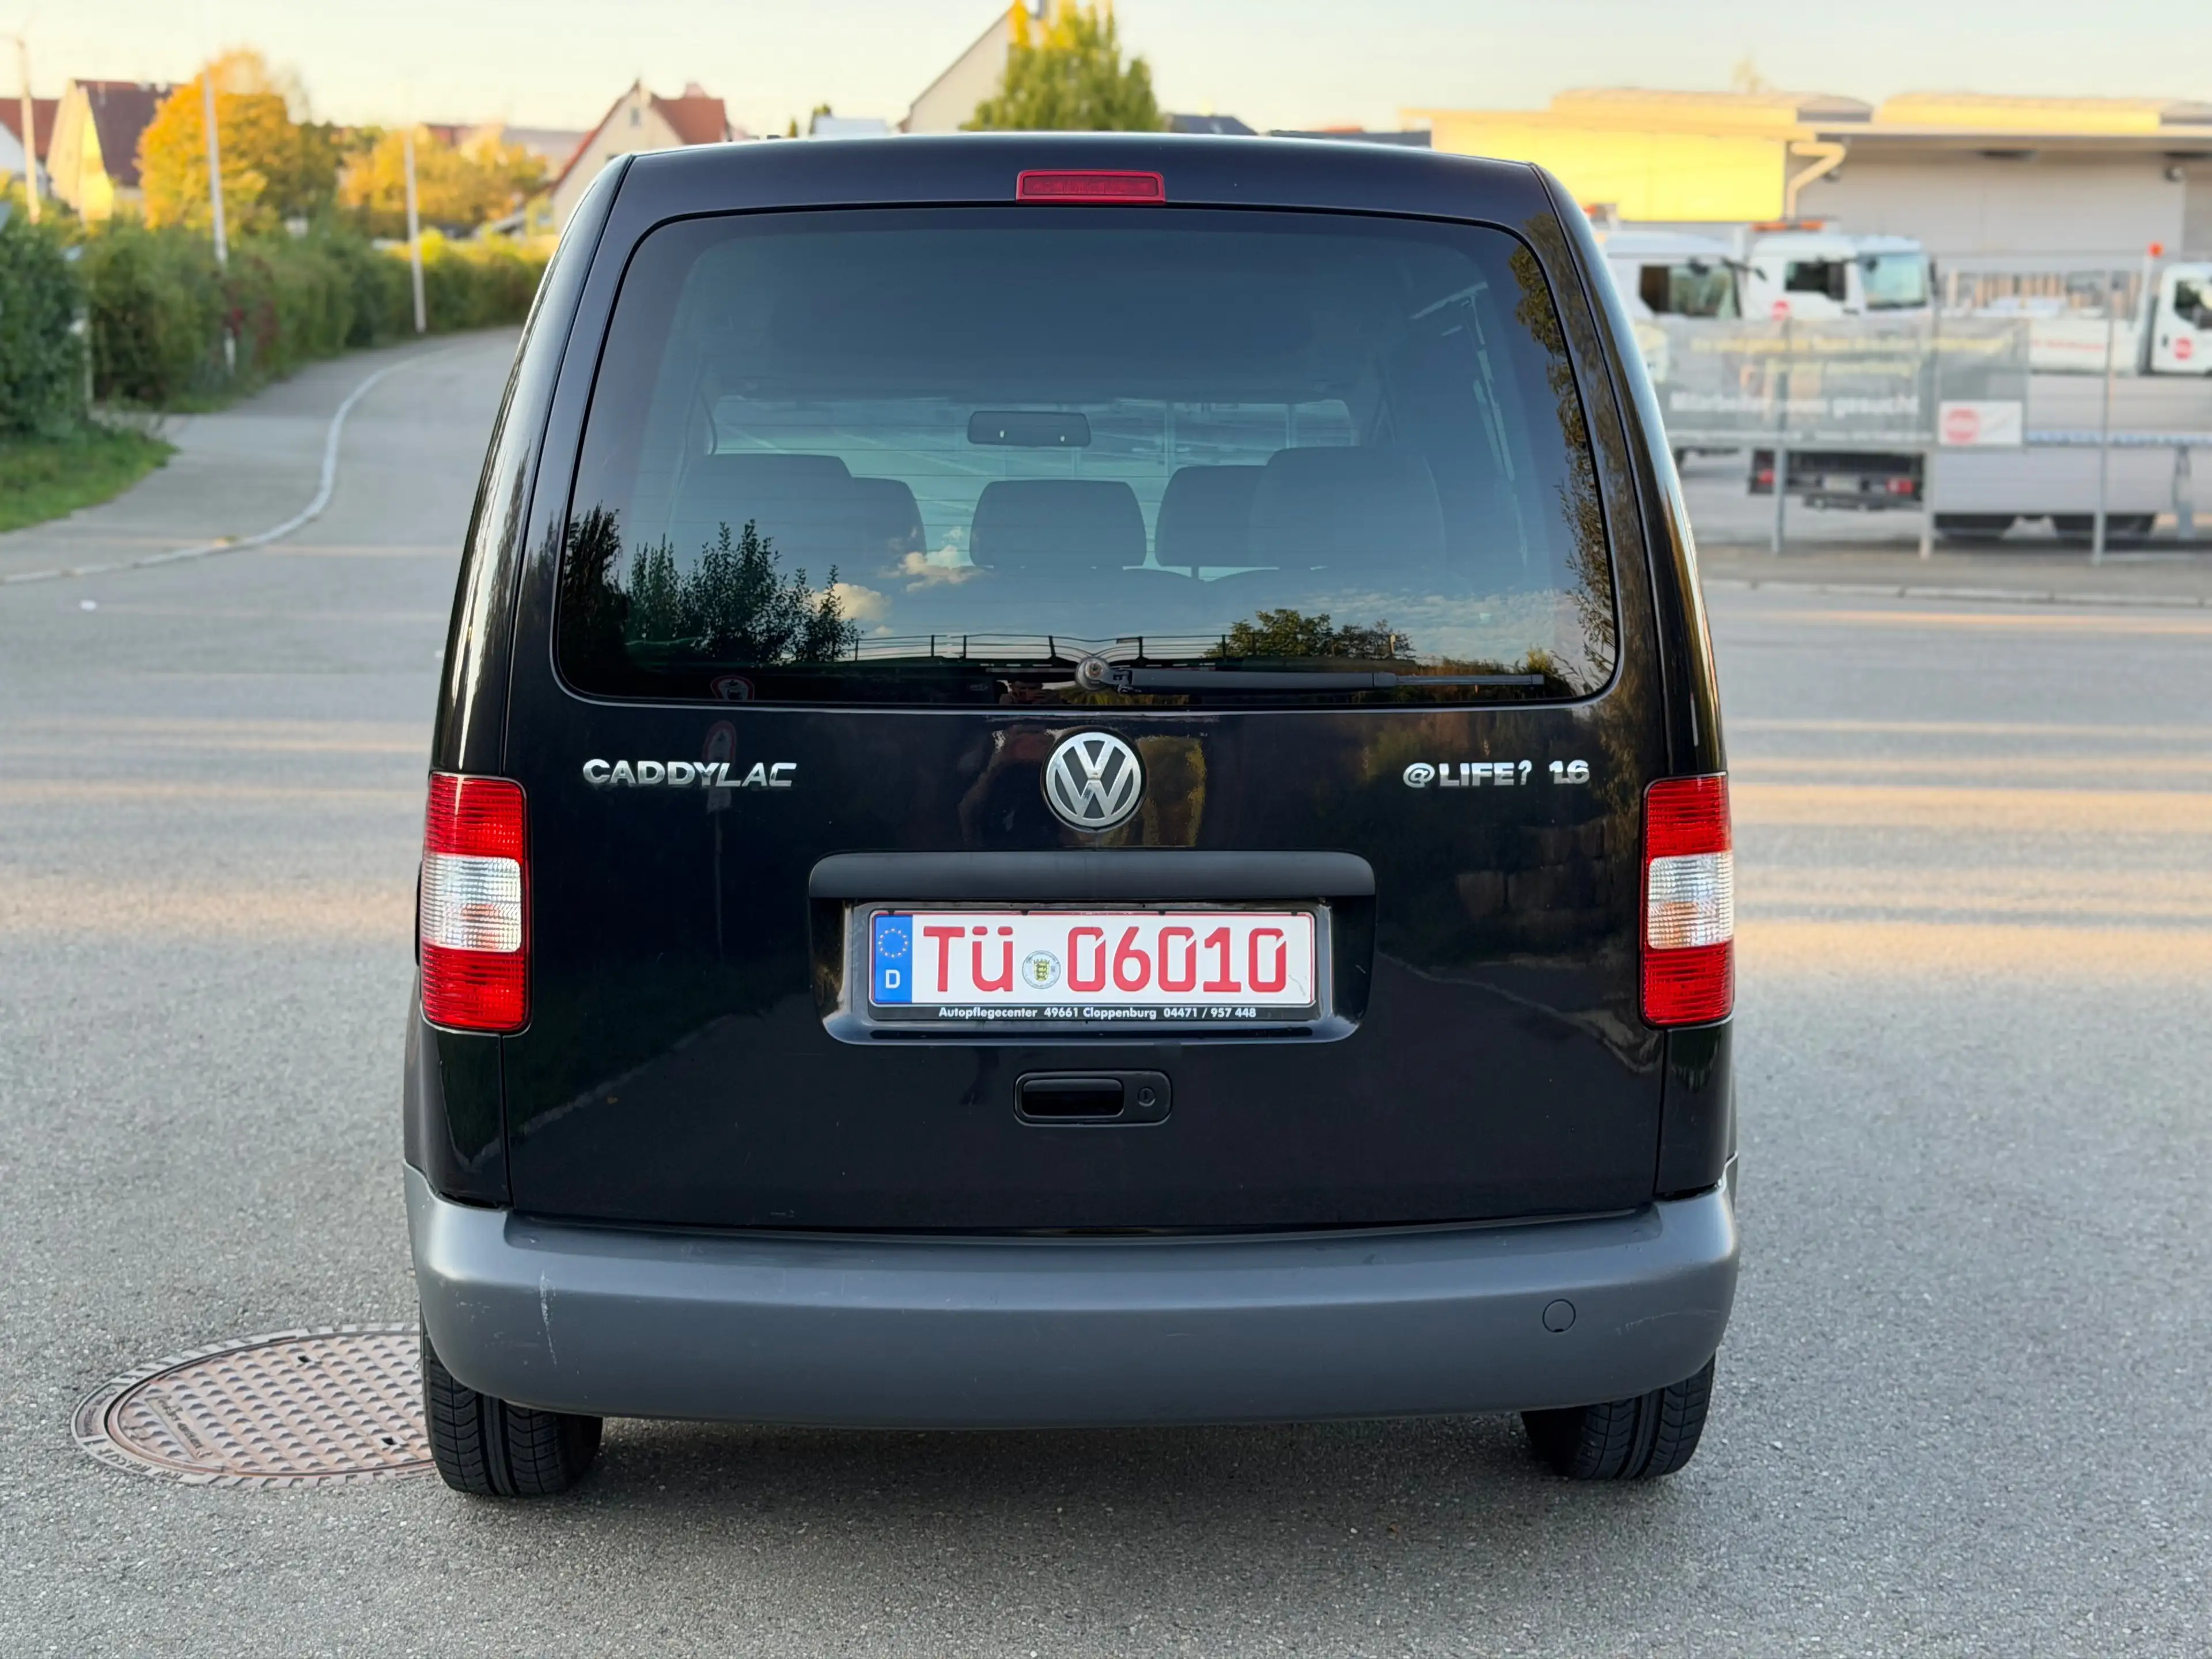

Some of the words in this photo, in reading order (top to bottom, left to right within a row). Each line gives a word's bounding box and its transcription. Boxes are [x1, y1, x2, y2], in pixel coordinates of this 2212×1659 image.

[582, 759, 797, 787] CADDYLAC
[1403, 759, 1533, 788] @LIFE?
[923, 926, 1013, 993] TÜ
[1067, 926, 1287, 993] 06010
[885, 969, 900, 989] D
[938, 1007, 1038, 1020] Autopflegecenter
[1043, 1007, 1078, 1018] 49661
[1082, 1007, 1157, 1020] Cloppenburg
[1163, 1007, 1198, 1018] 04471
[1201, 1007, 1208, 1018] /
[1210, 1007, 1232, 1018] 957
[1234, 1007, 1256, 1018] 448
